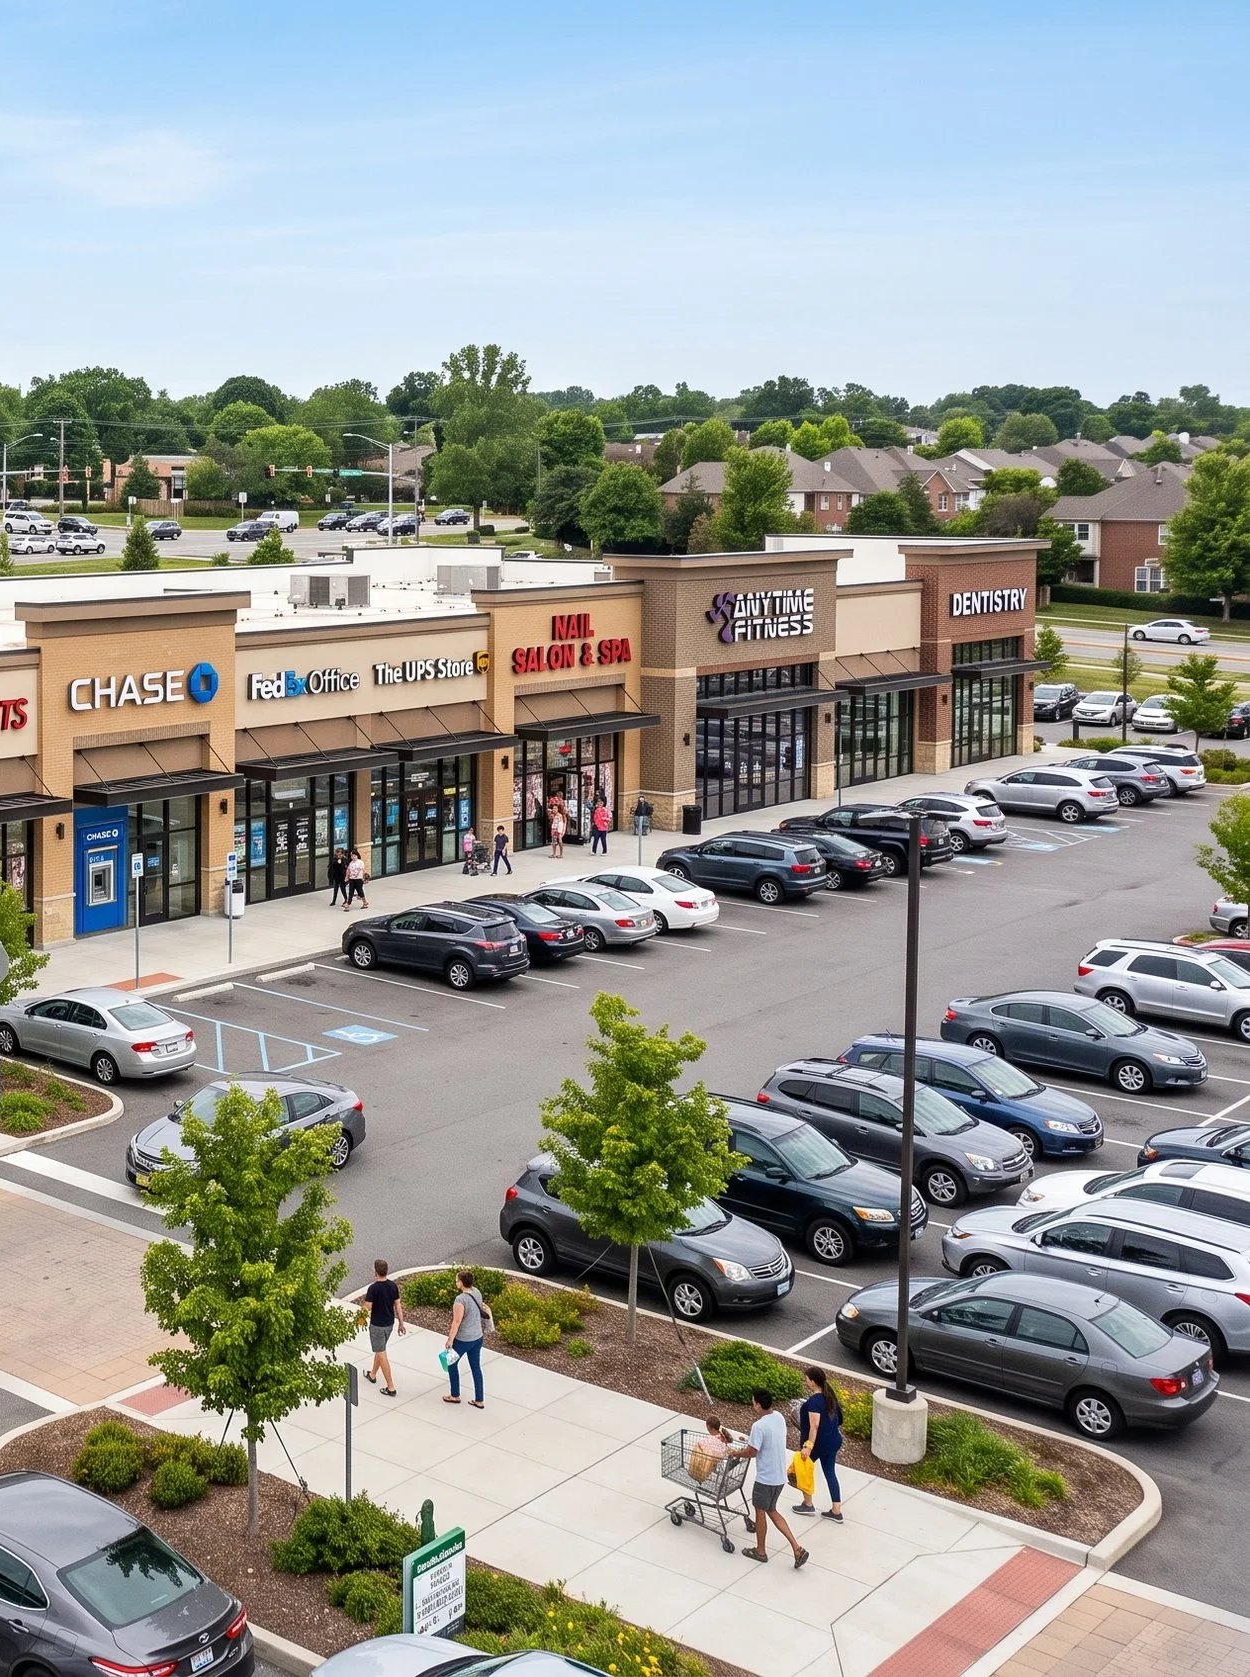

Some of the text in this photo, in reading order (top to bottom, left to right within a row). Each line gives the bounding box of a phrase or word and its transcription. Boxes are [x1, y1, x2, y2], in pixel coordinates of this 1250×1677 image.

[732, 588, 814, 618] ANYTIME
[950, 587, 1027, 617] DENTISTRY
[552, 613, 594, 640] NAIL
[733, 614, 813, 642] FITNESS
[374, 657, 474, 685] The UPS Store
[513, 638, 631, 674] SALON & SPA
[69, 669, 186, 711] CHASE
[249, 668, 360, 700] FedEx Office
